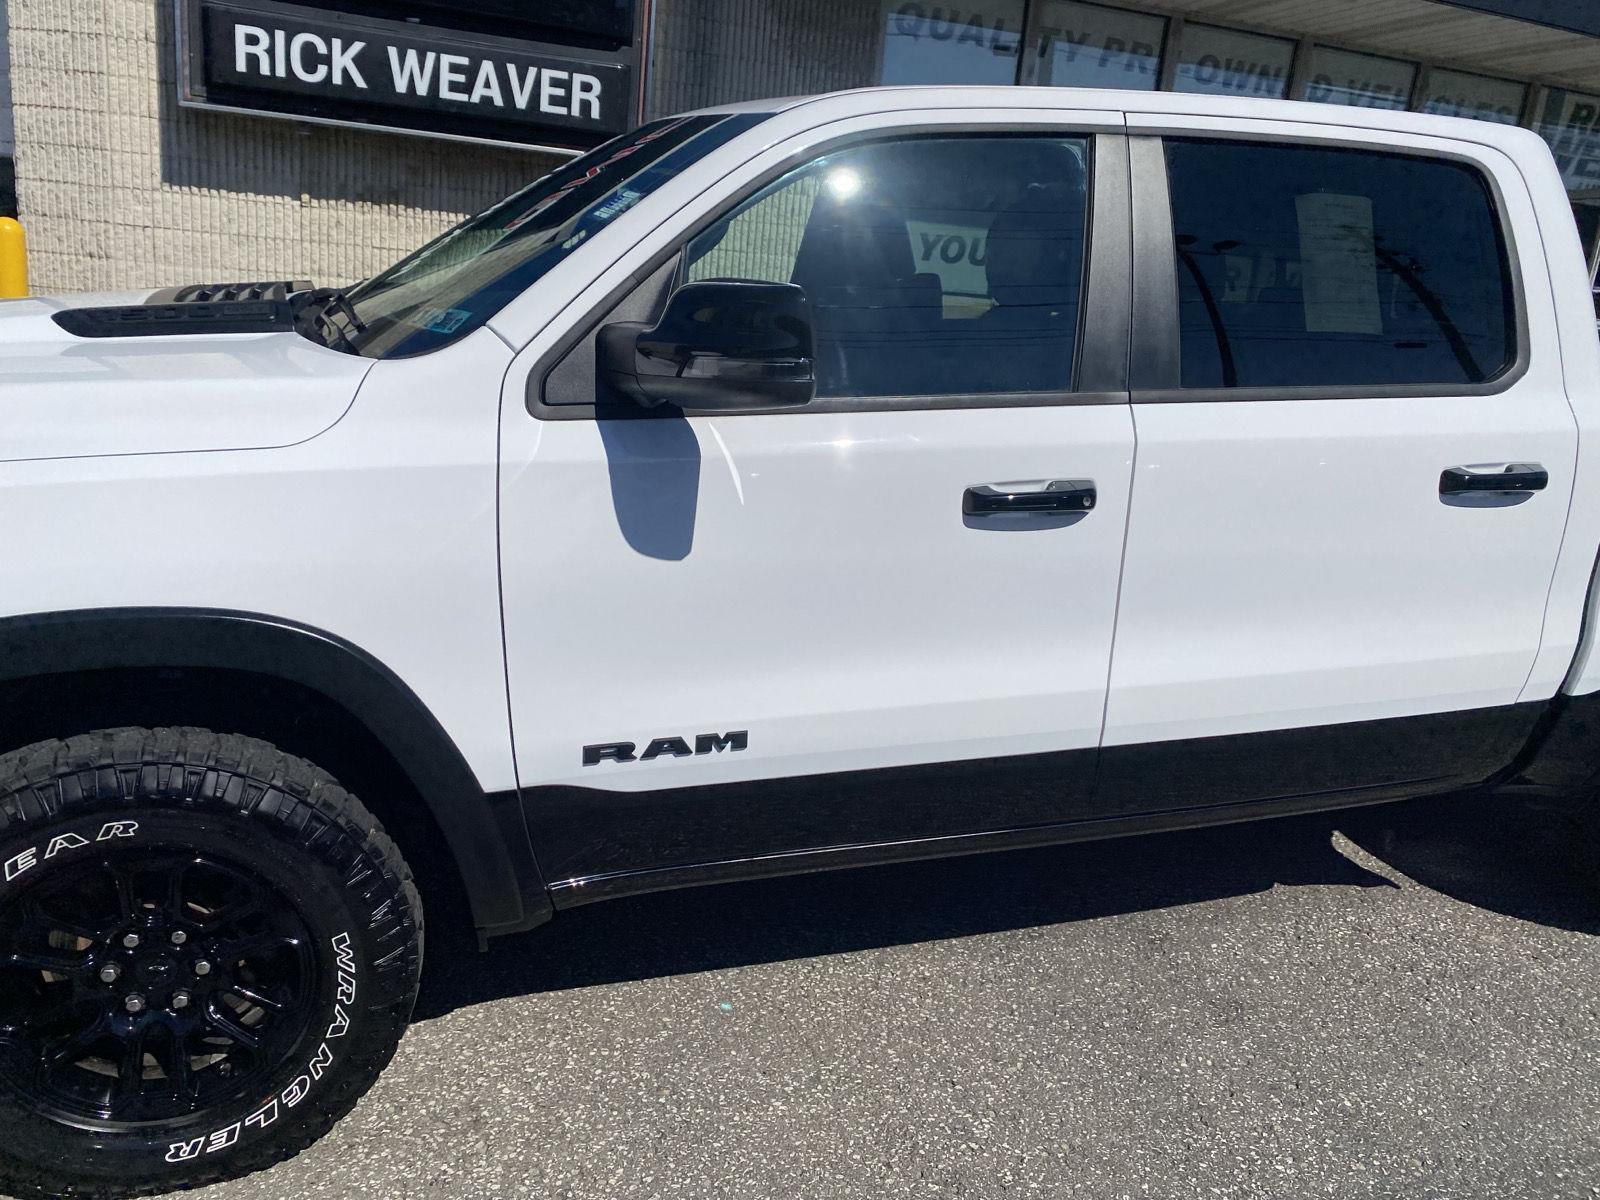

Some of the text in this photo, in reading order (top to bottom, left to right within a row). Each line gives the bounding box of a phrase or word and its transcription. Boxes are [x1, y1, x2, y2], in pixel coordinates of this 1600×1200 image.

[234, 24, 601, 120] RICK WEAVER
[583, 730, 748, 767] RAM
[4, 821, 139, 882] EAR
[165, 932, 356, 1162] WRANGLER
